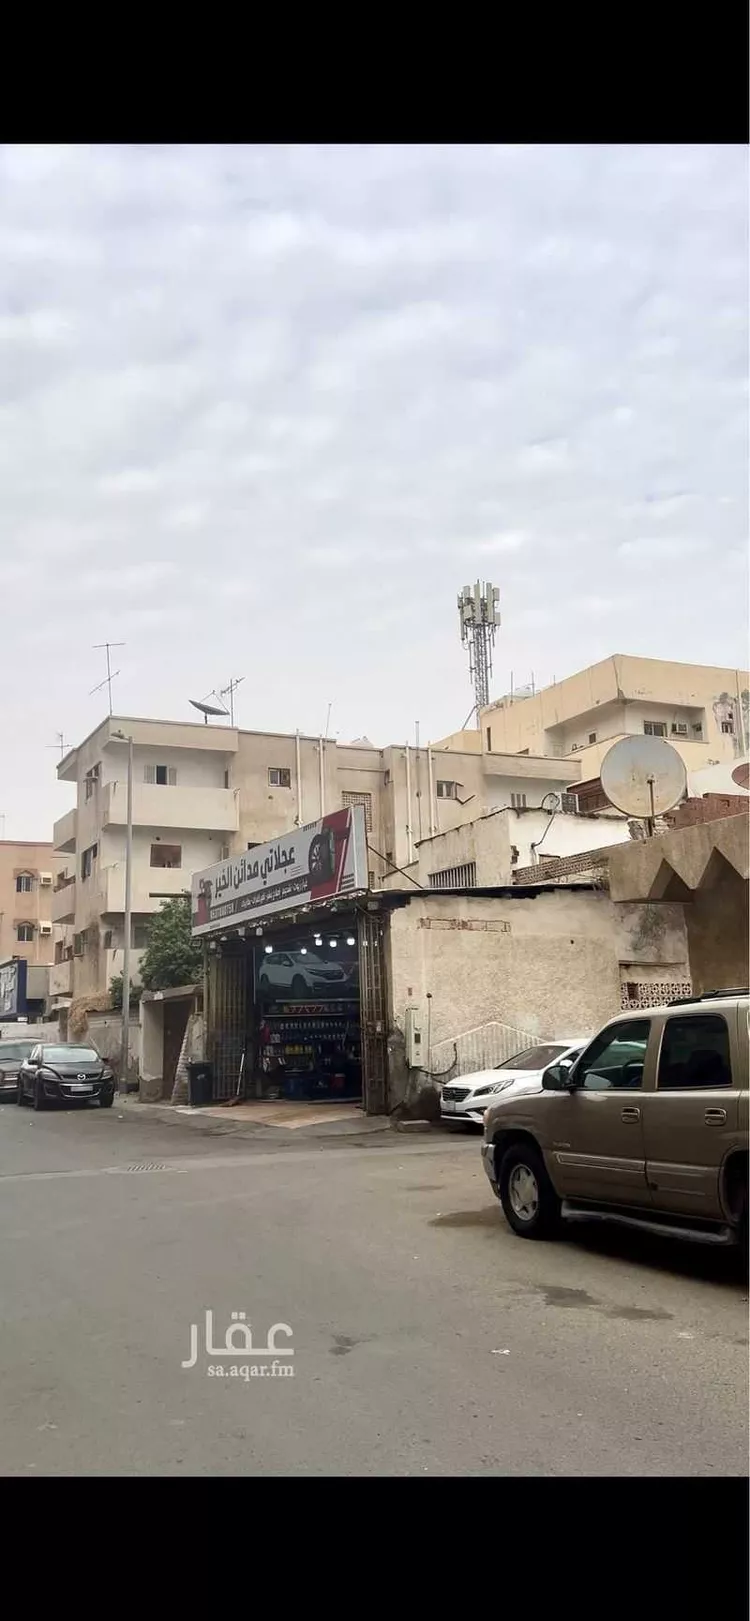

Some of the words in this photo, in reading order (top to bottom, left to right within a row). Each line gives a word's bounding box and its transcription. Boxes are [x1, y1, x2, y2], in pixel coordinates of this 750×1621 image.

[233, 858, 259, 890] مدائن
[260, 844, 296, 886] عجلاتي
[214, 866, 233, 899] الخبر
